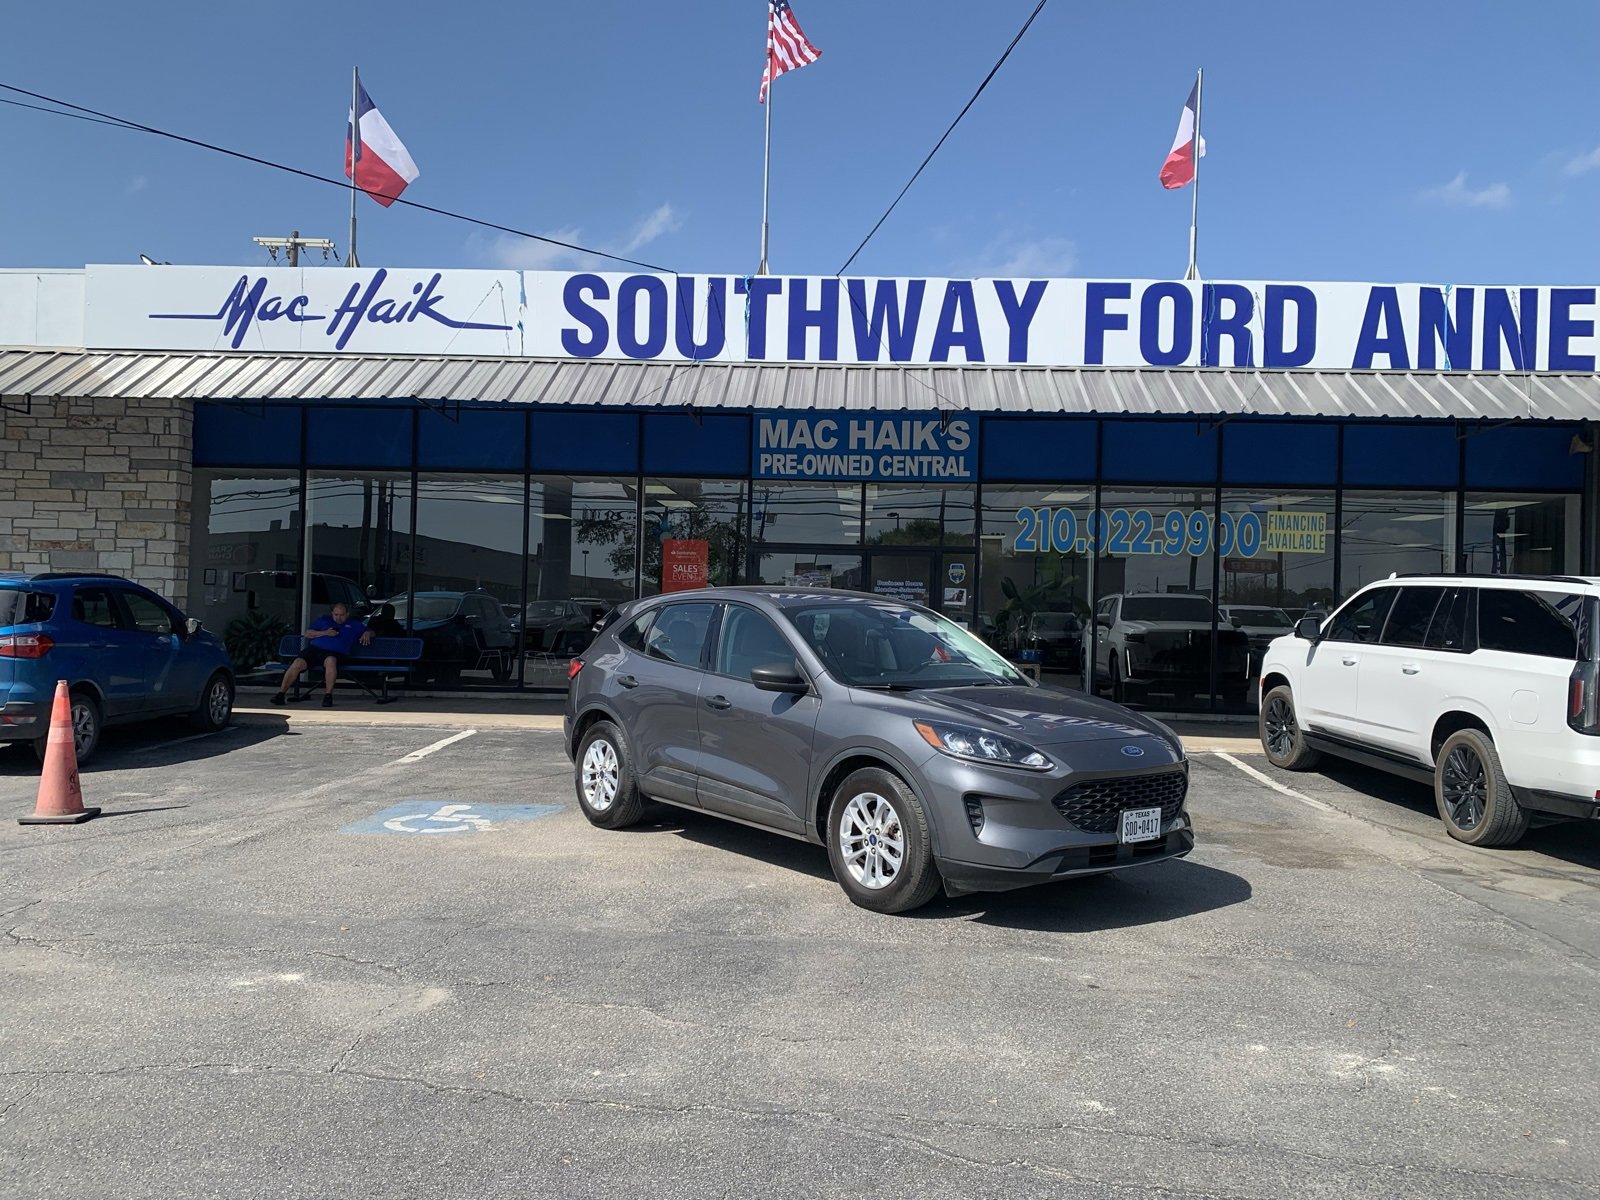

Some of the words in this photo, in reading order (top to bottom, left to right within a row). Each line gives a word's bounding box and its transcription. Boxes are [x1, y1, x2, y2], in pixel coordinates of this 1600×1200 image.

[149, 275, 325, 349] Mac
[327, 268, 513, 350] Haik
[561, 273, 1049, 363] SOUTHWAY
[1084, 281, 1317, 368] FORD
[1352, 286, 1596, 371] ANNE
[759, 419, 838, 449] MAC
[760, 454, 874, 476] PRE-OWNED
[878, 455, 971, 477] CENTRAL
[1014, 506, 1261, 558] 210.922.9900
[1268, 514, 1325, 532] FINANCING
[1268, 534, 1326, 551] AVAILABLE
[672, 564, 698, 573] SALES
[672, 573, 699, 581] EVENT
